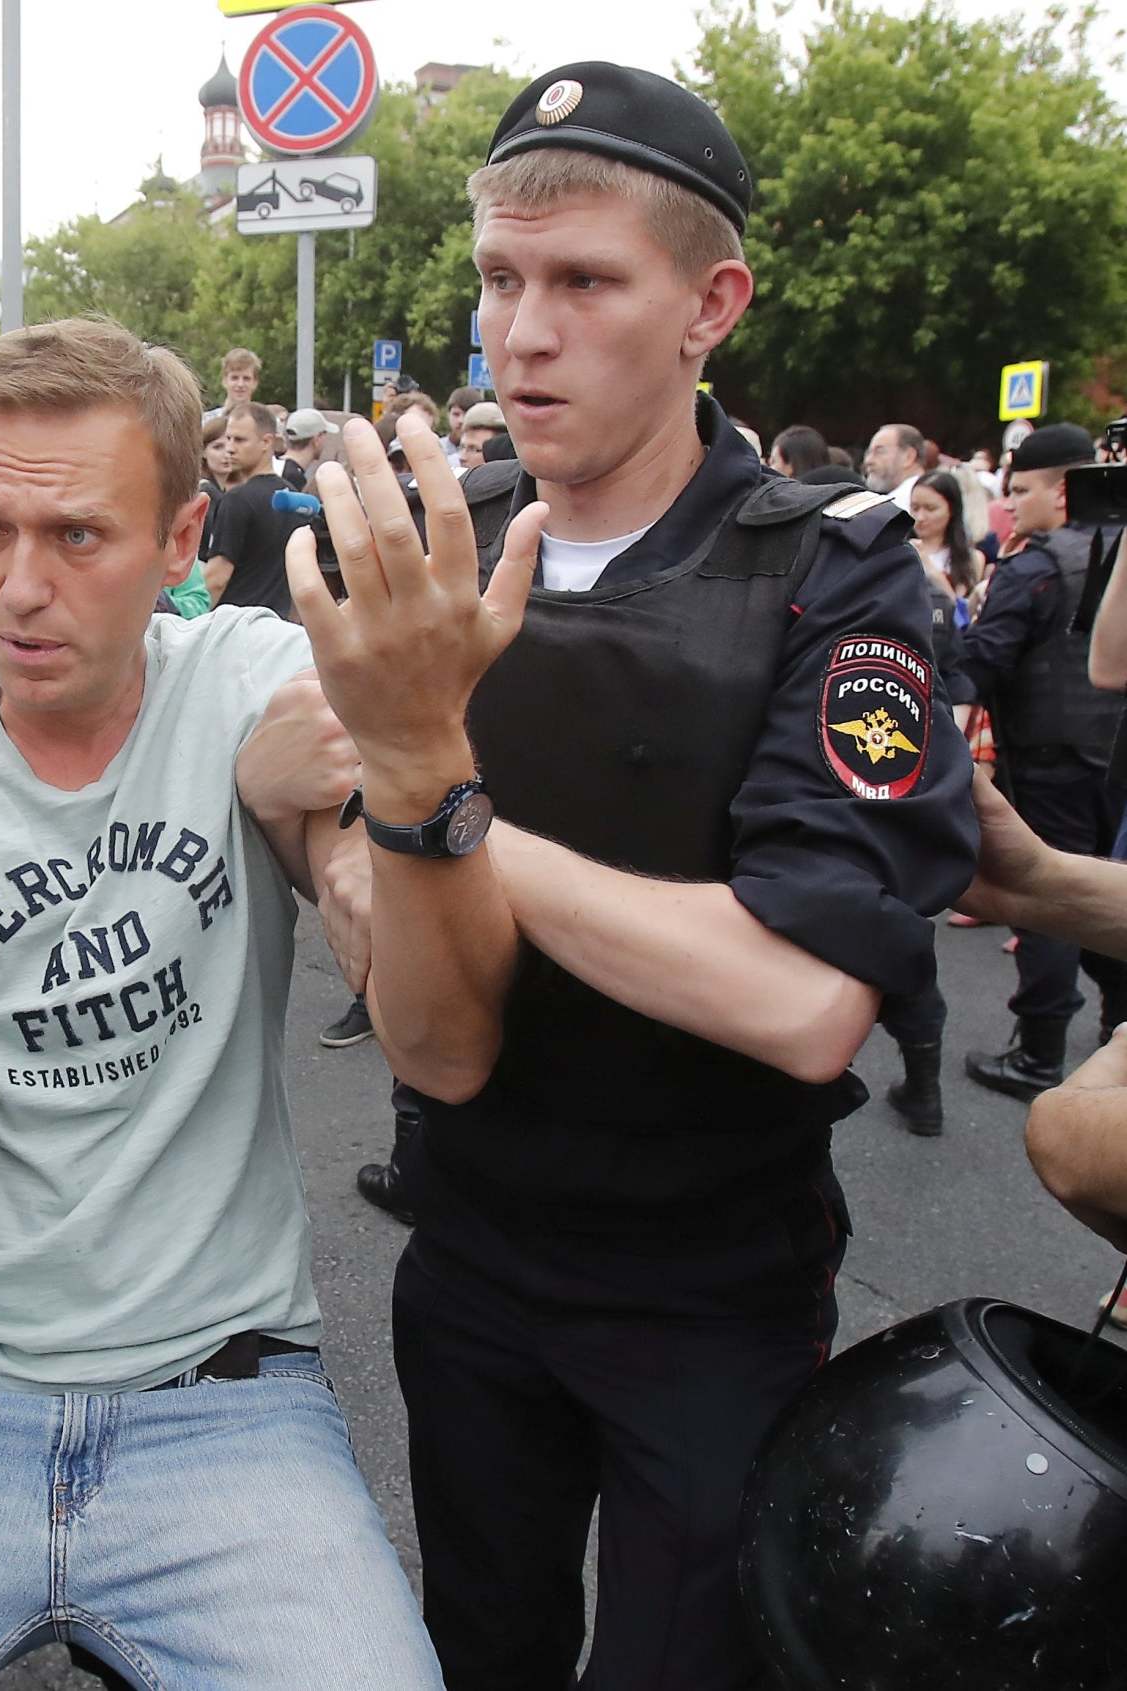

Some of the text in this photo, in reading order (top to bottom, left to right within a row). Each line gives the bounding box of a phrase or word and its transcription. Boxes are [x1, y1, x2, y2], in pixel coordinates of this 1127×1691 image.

[380, 344, 397, 366] P
[839, 642, 926, 684] ПОЛИЦИЯ
[838, 678, 920, 722] РОССИЯ
[851, 775, 890, 800] МВД
[41, 910, 151, 994] AND
[12, 956, 188, 1052] FITCH
[7, 1002, 203, 1089] ESTABLISHED 92
